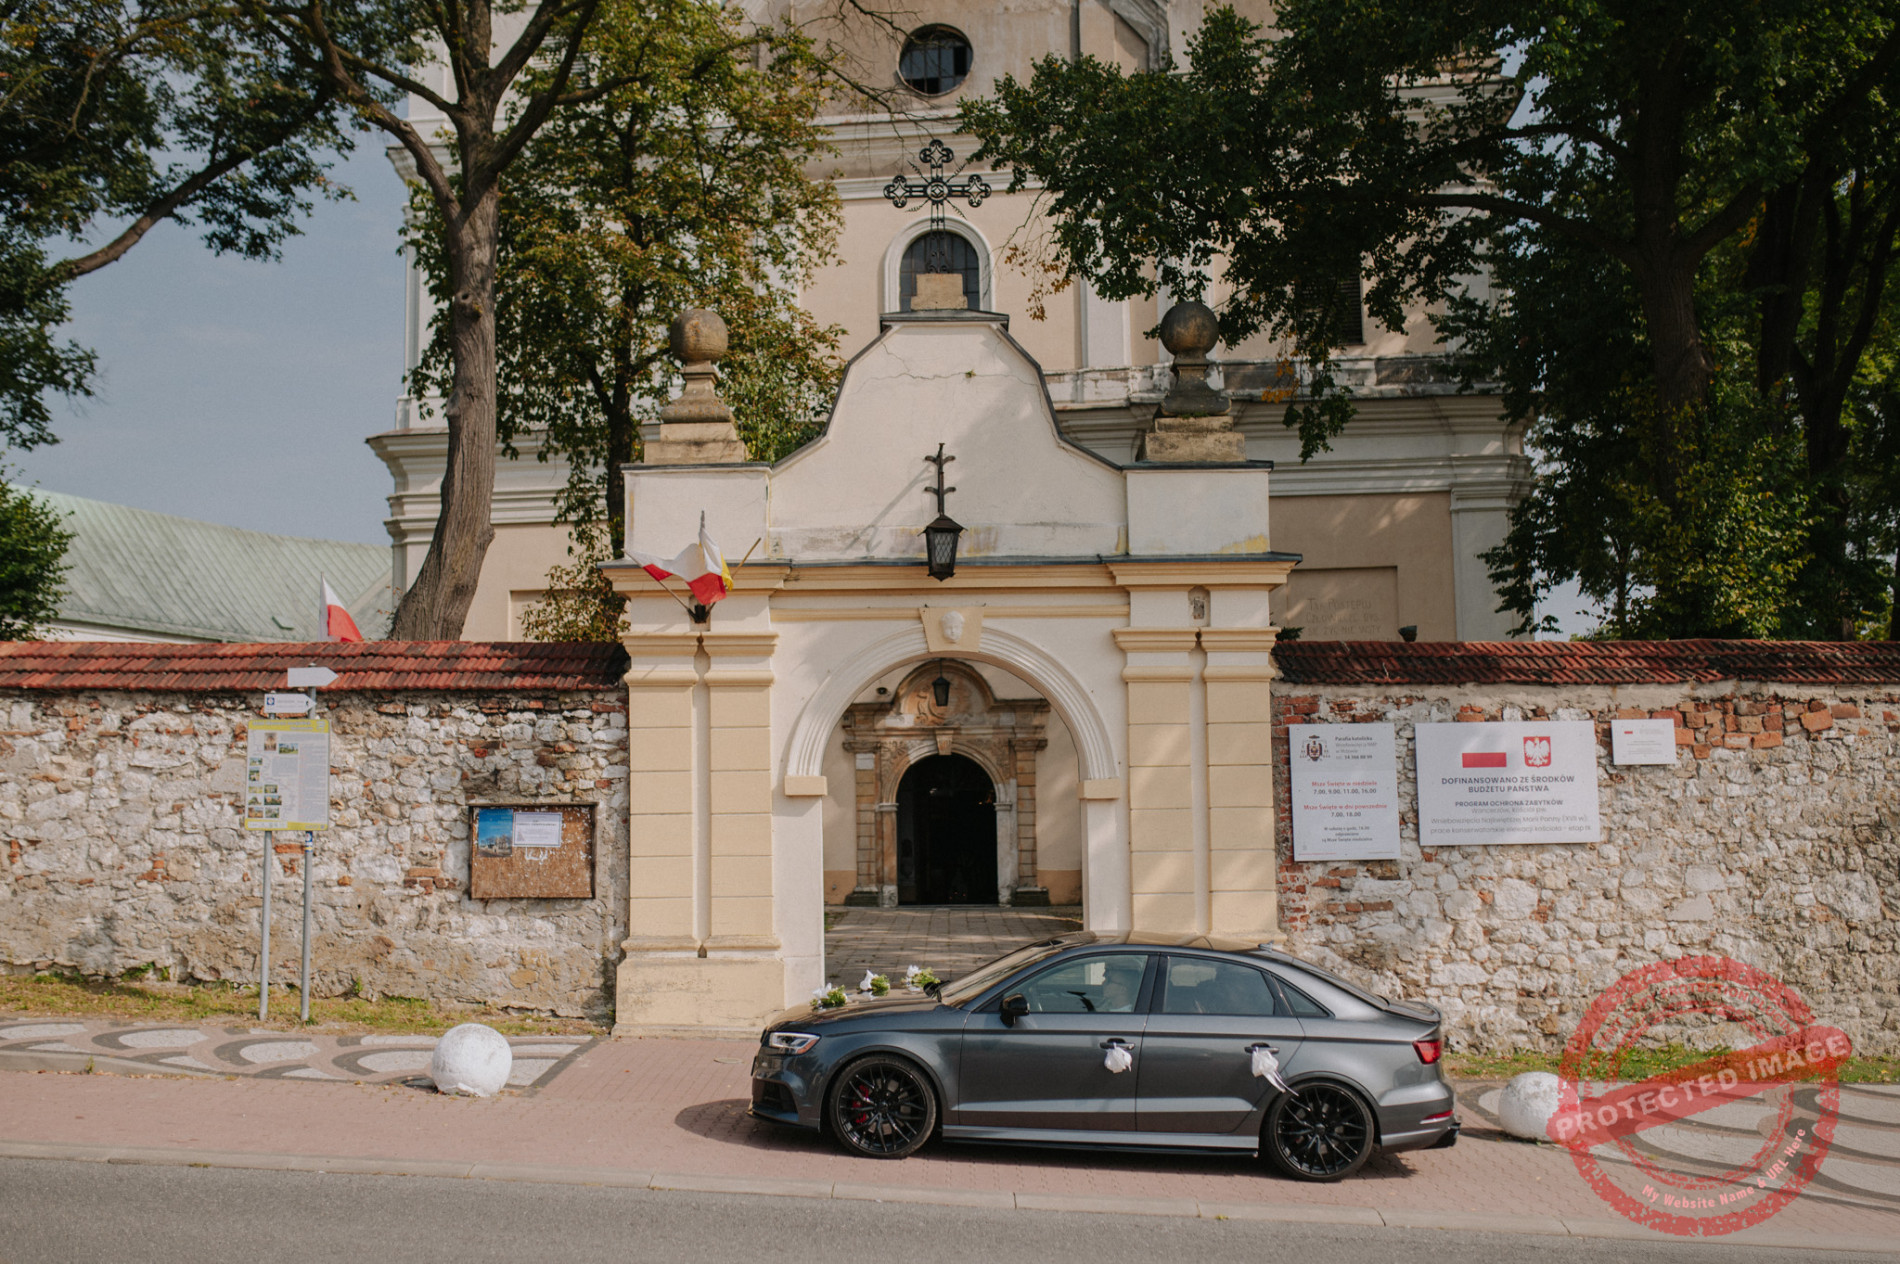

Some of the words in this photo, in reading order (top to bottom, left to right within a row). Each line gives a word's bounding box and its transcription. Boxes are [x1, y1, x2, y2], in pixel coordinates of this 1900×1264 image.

[1441, 776, 1518, 785] DOFINANSOWANO
[1531, 774, 1575, 783] ŚRODKÓW
[1468, 784, 1506, 793] BUDŻETU
[1507, 784, 1550, 792] PAŃSTWA
[1525, 798, 1564, 806] ZABYTKÓW
